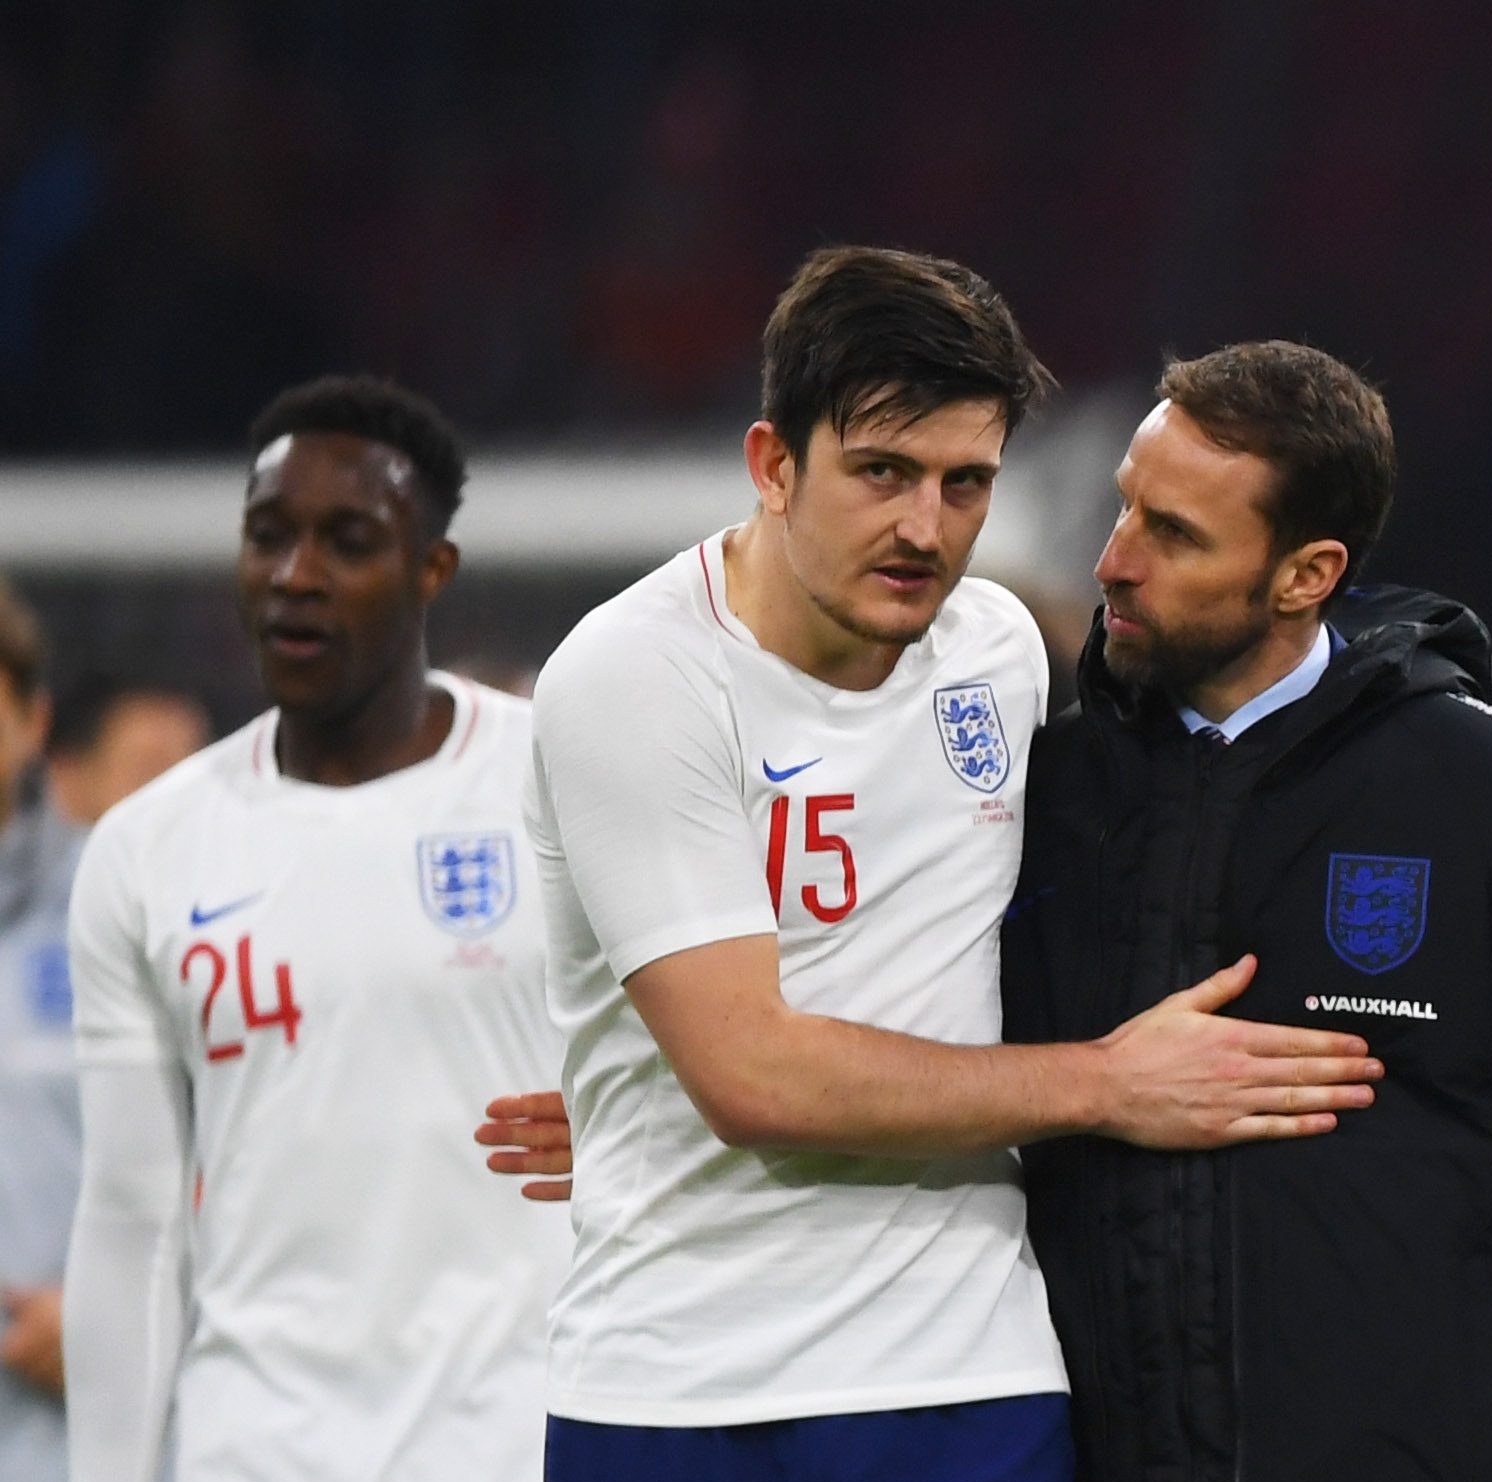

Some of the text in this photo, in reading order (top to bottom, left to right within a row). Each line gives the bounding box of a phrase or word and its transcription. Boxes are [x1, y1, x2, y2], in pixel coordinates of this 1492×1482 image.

[766, 793, 858, 926] 15
[180, 934, 303, 1063] 24
[1319, 995, 1438, 1020] VAUXHALL
